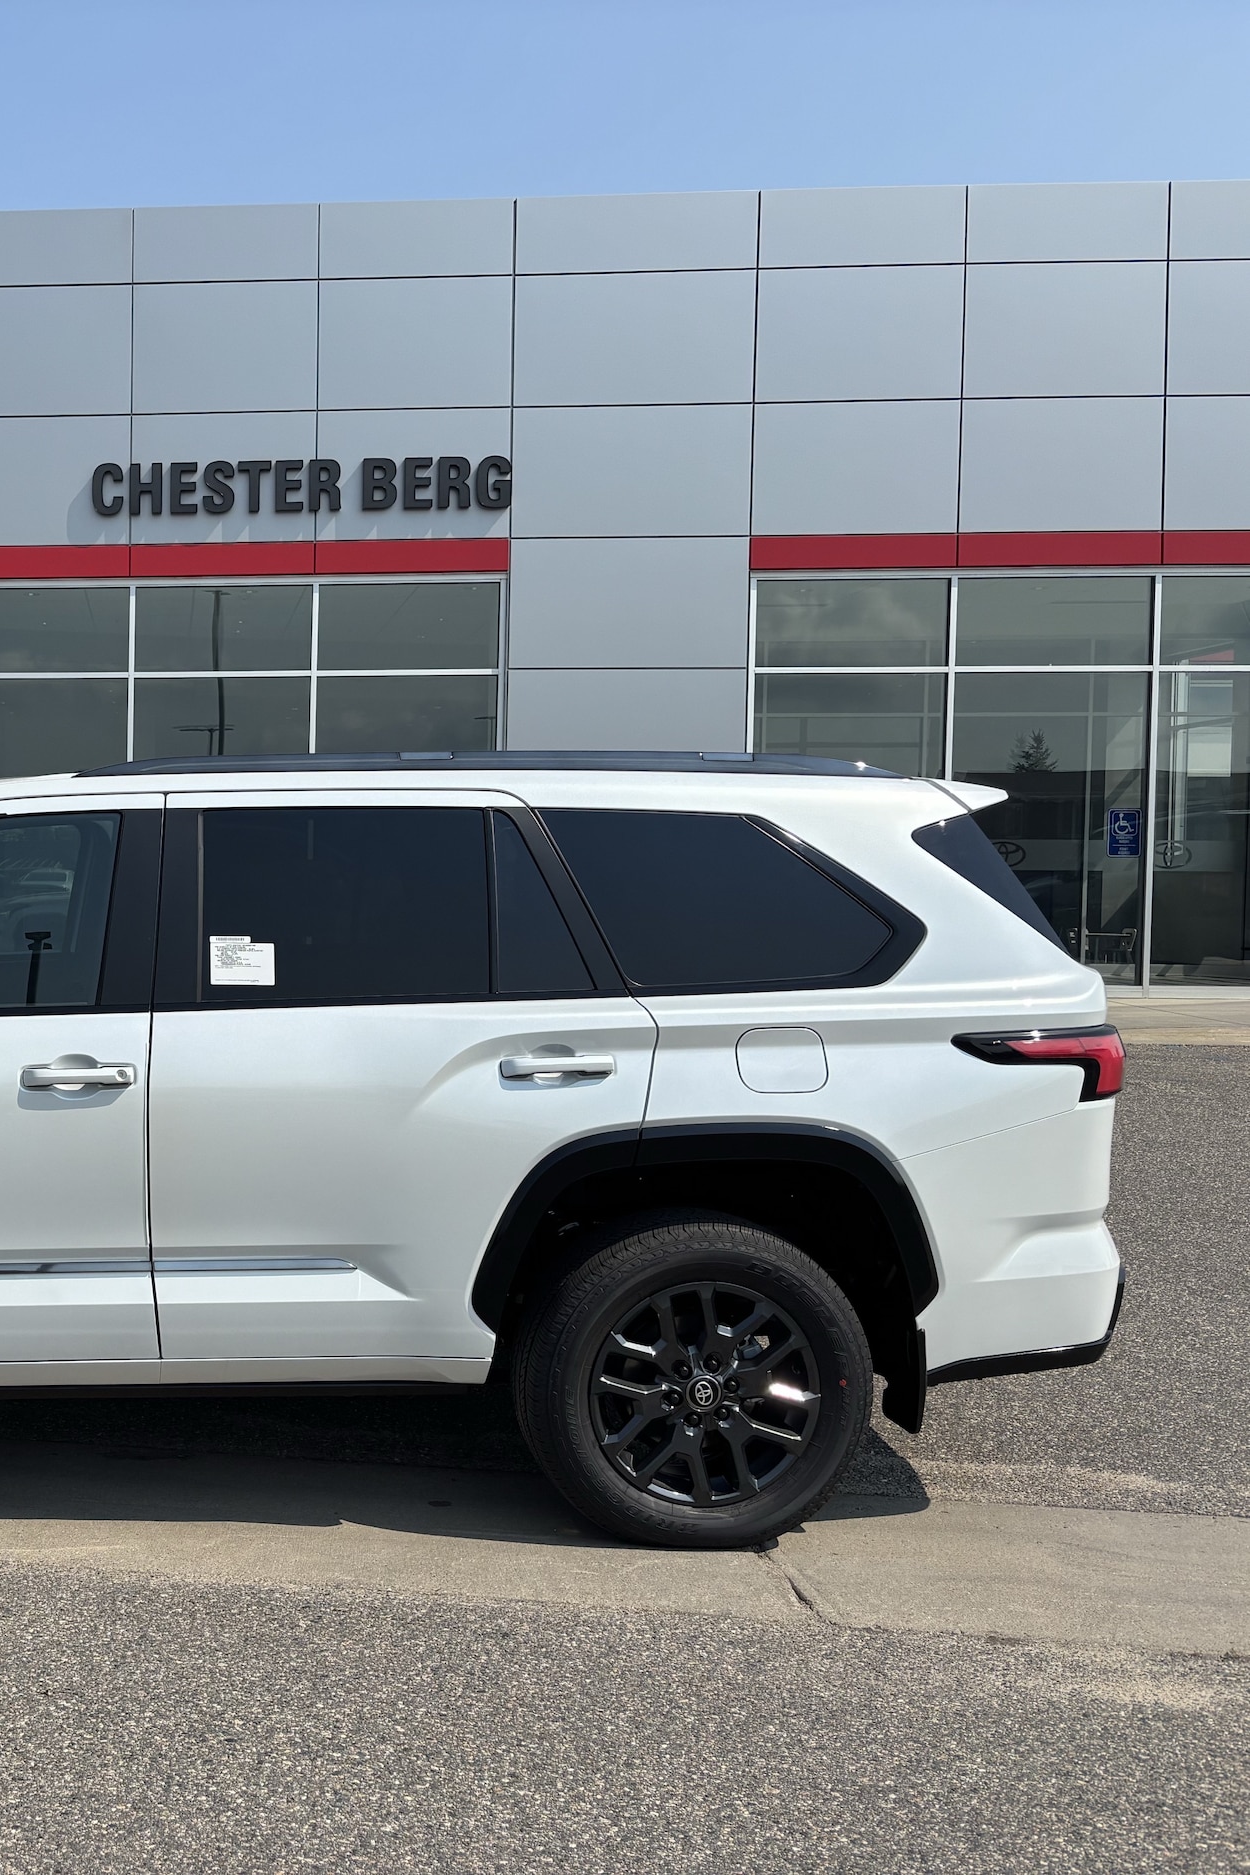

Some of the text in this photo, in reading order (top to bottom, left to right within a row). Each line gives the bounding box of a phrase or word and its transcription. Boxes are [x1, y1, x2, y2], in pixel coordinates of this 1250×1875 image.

[91, 455, 512, 516] CHESTER BERG
[565, 1384, 703, 1535] BRIDGESTONE
